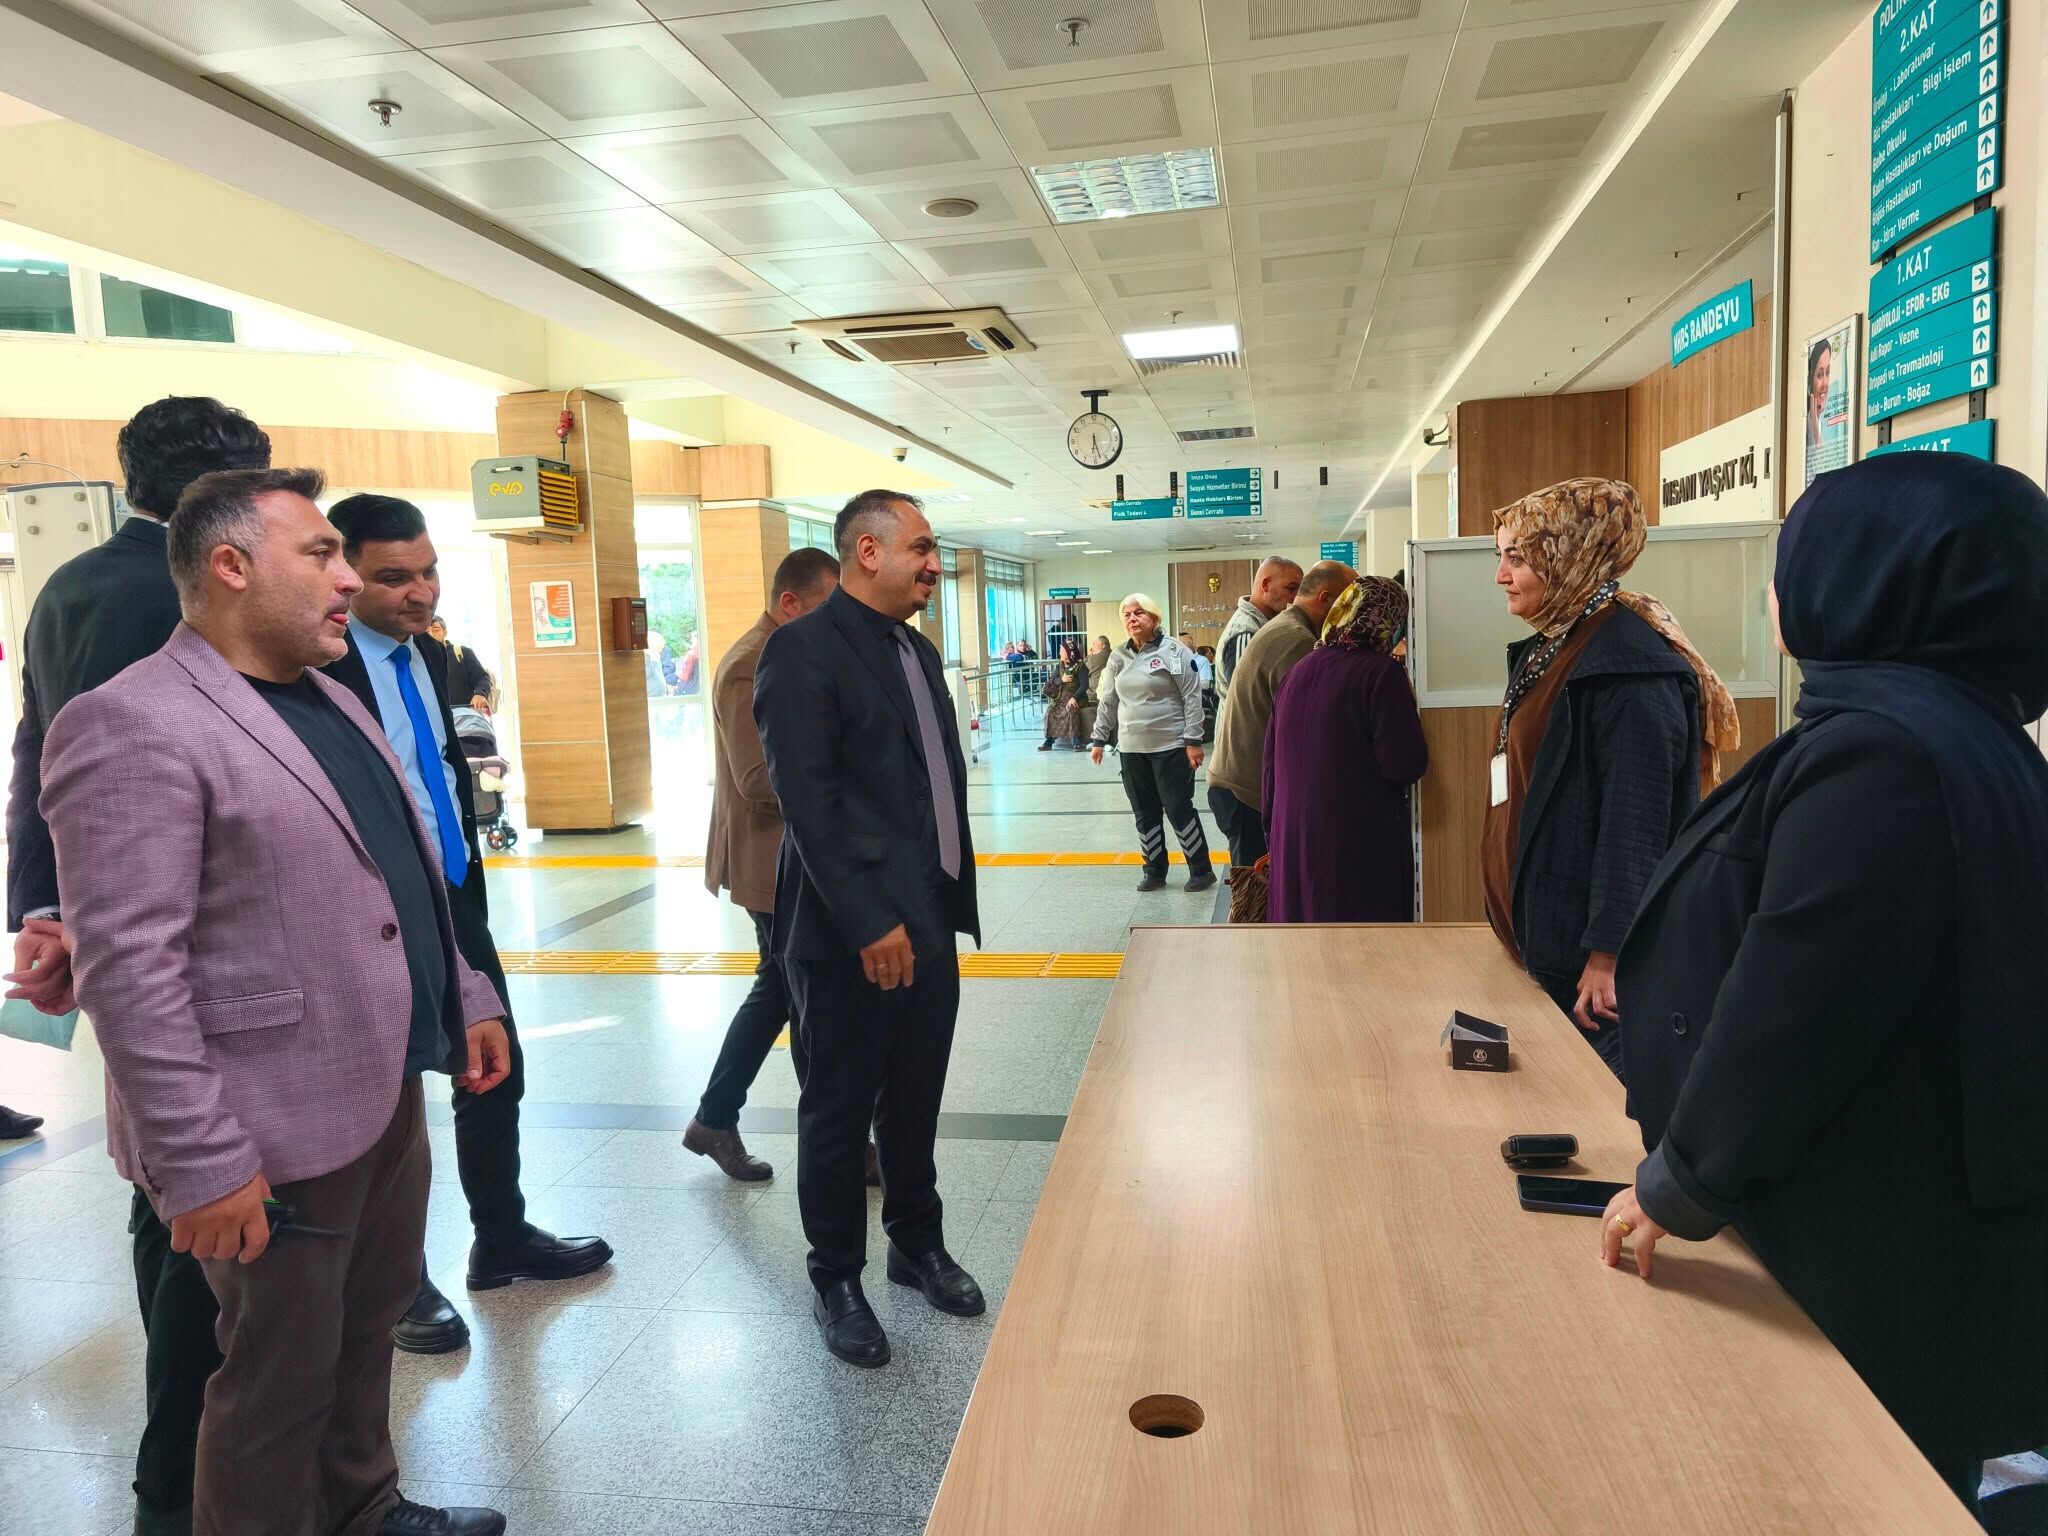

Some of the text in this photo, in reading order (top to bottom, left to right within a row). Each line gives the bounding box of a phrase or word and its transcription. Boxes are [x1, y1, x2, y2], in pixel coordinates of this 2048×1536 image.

[1900, 0, 1937, 53] 2.KAT
[1893, 42, 1936, 91] Laboratuvar
[1923, 66, 1942, 95] Bilgi
[1943, 50, 1971, 81] İşlem
[1886, 128, 1907, 157] Okulu
[1886, 149, 1921, 186] Hastalıkları
[1922, 142, 1932, 158] ve
[1934, 120, 1968, 151] Doğum
[1886, 178, 1922, 215] Hastalıkları
[1897, 209, 1921, 233] Verme
[1897, 245, 1932, 285] 1.KAT
[1905, 292, 1925, 317] EFOR
[1931, 281, 1950, 305] EKG
[1689, 295, 1739, 345] RANDEVU
[1899, 327, 1920, 347] Vezne
[1895, 345, 1944, 378] Travmatoloji
[1907, 382, 1931, 403] Boğaz
[1662, 472, 1697, 509] İNSANI
[1697, 458, 1739, 502] YAŞAT
